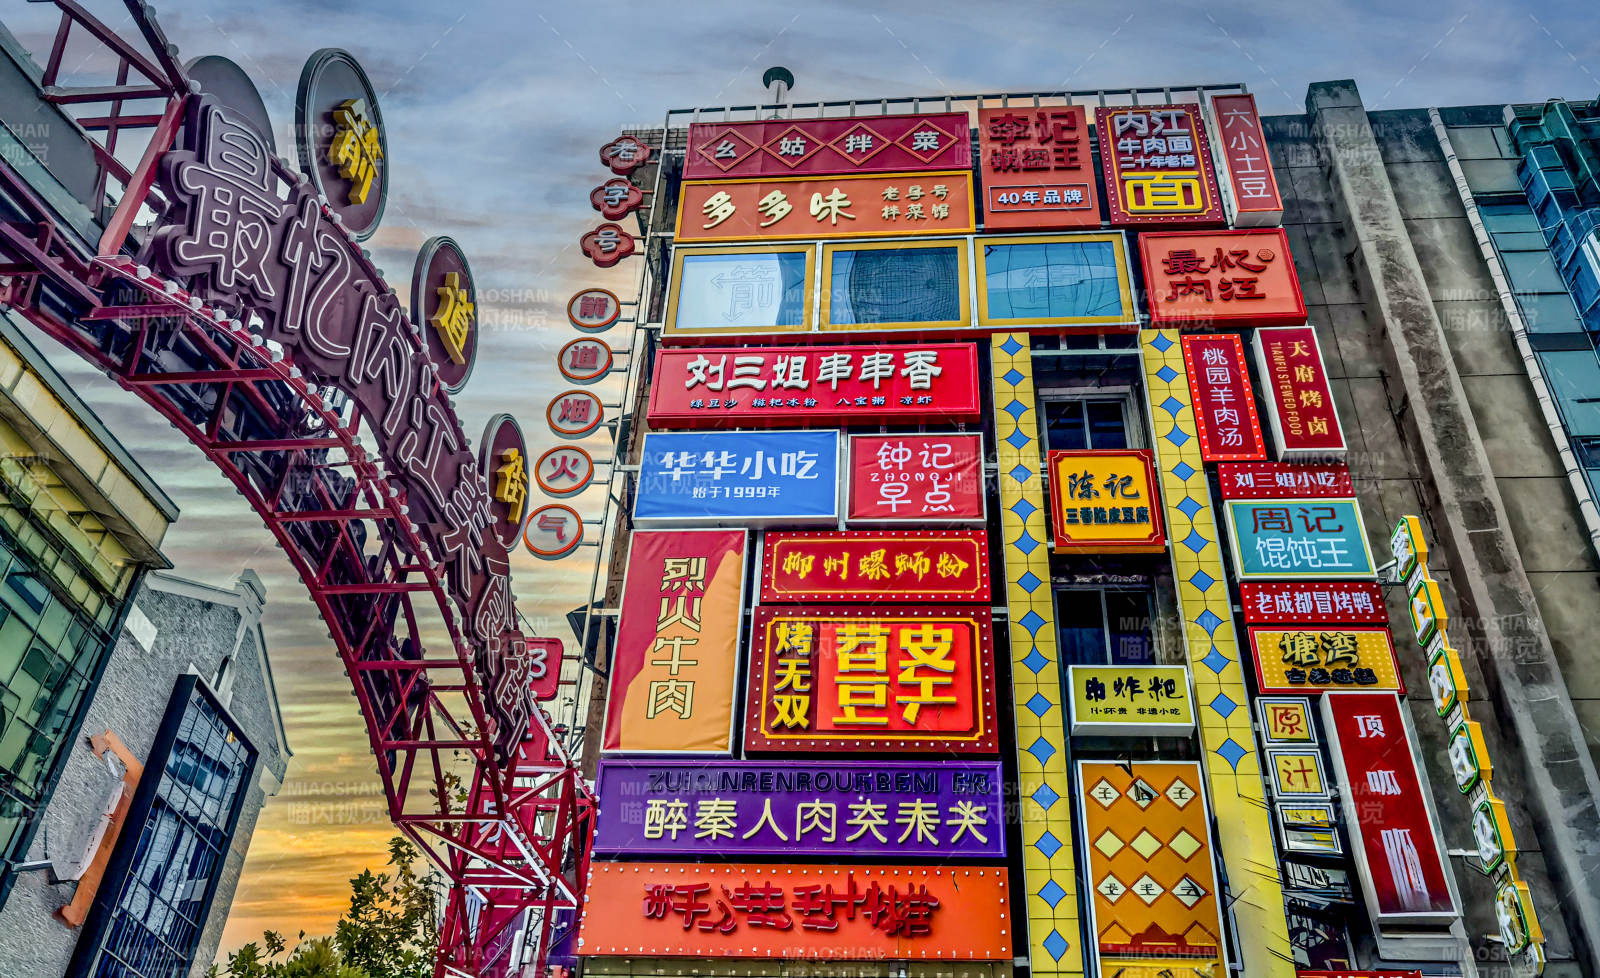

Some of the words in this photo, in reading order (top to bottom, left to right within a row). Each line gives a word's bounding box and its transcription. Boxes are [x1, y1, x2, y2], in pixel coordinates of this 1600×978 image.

[1114, 110, 1190, 137] 内江
[714, 131, 940, 160] 幺姑拌菜
[1118, 136, 1193, 156] 牛肉面
[1223, 108, 1272, 199] 六小土豆
[998, 189, 1083, 205] 40年品牌
[1121, 170, 1202, 213] 面
[702, 187, 856, 230] 多多味
[1161, 247, 1267, 275] 最忆
[1165, 276, 1266, 301] 内江
[685, 351, 942, 391] 刘三姐串串香
[1270, 341, 1288, 374] TIANFU
[1202, 348, 1243, 447] 桃园羊肉汤
[1277, 373, 1297, 409] STEWED
[1287, 340, 1329, 436] 天府烤卤
[1286, 410, 1304, 437] FOOD
[659, 450, 819, 481] 华华小吃
[876, 441, 954, 471] 钟记
[692, 485, 781, 499] 始于1999年
[870, 472, 962, 482] ZHONGJI
[1067, 469, 1140, 499] 陈记
[1233, 471, 1338, 488] 刘三姐小吃
[876, 481, 955, 513] 早点
[1251, 506, 1344, 534] 周记
[1256, 536, 1353, 569] 馄饨王
[1255, 591, 1376, 615] 老成都冒烤鸭
[646, 556, 708, 720] 烈火牛肉
[1279, 632, 1360, 668] 塘湾
[771, 621, 813, 730] 烤无双
